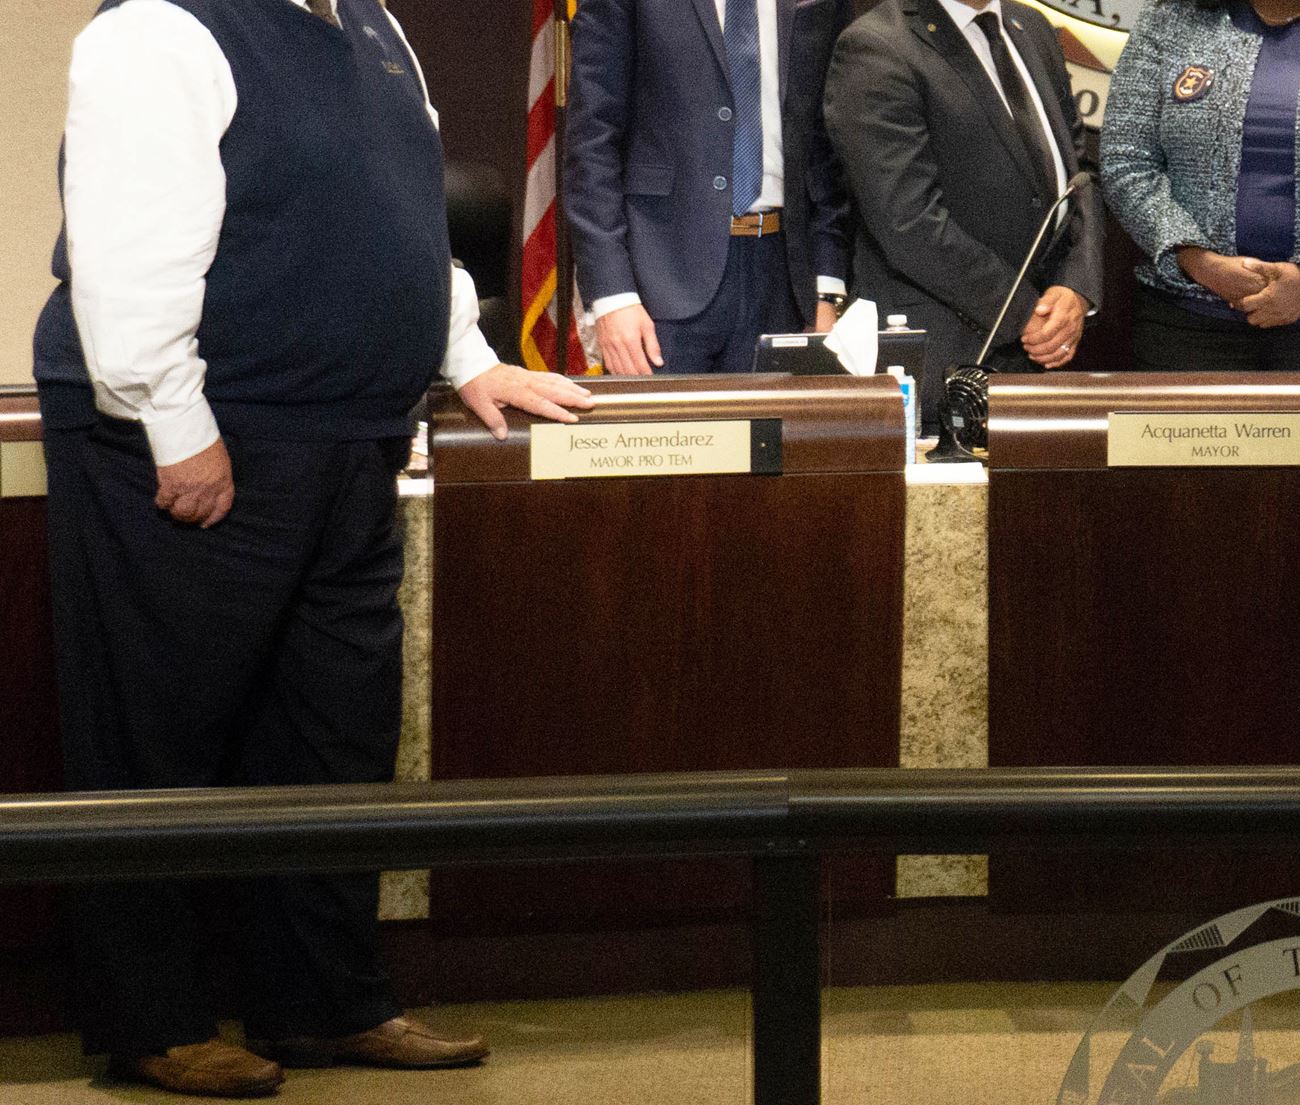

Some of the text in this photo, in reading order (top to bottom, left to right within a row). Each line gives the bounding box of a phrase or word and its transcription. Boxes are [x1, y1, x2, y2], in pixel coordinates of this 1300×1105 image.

[569, 431, 714, 452] Jesse Armendarez
[1141, 423, 1291, 443] Acquanetta Warren
[590, 454, 693, 468] MAYOR PRO TEM
[1191, 445, 1241, 458] MAYOR
[1191, 964, 1246, 1014] OF
